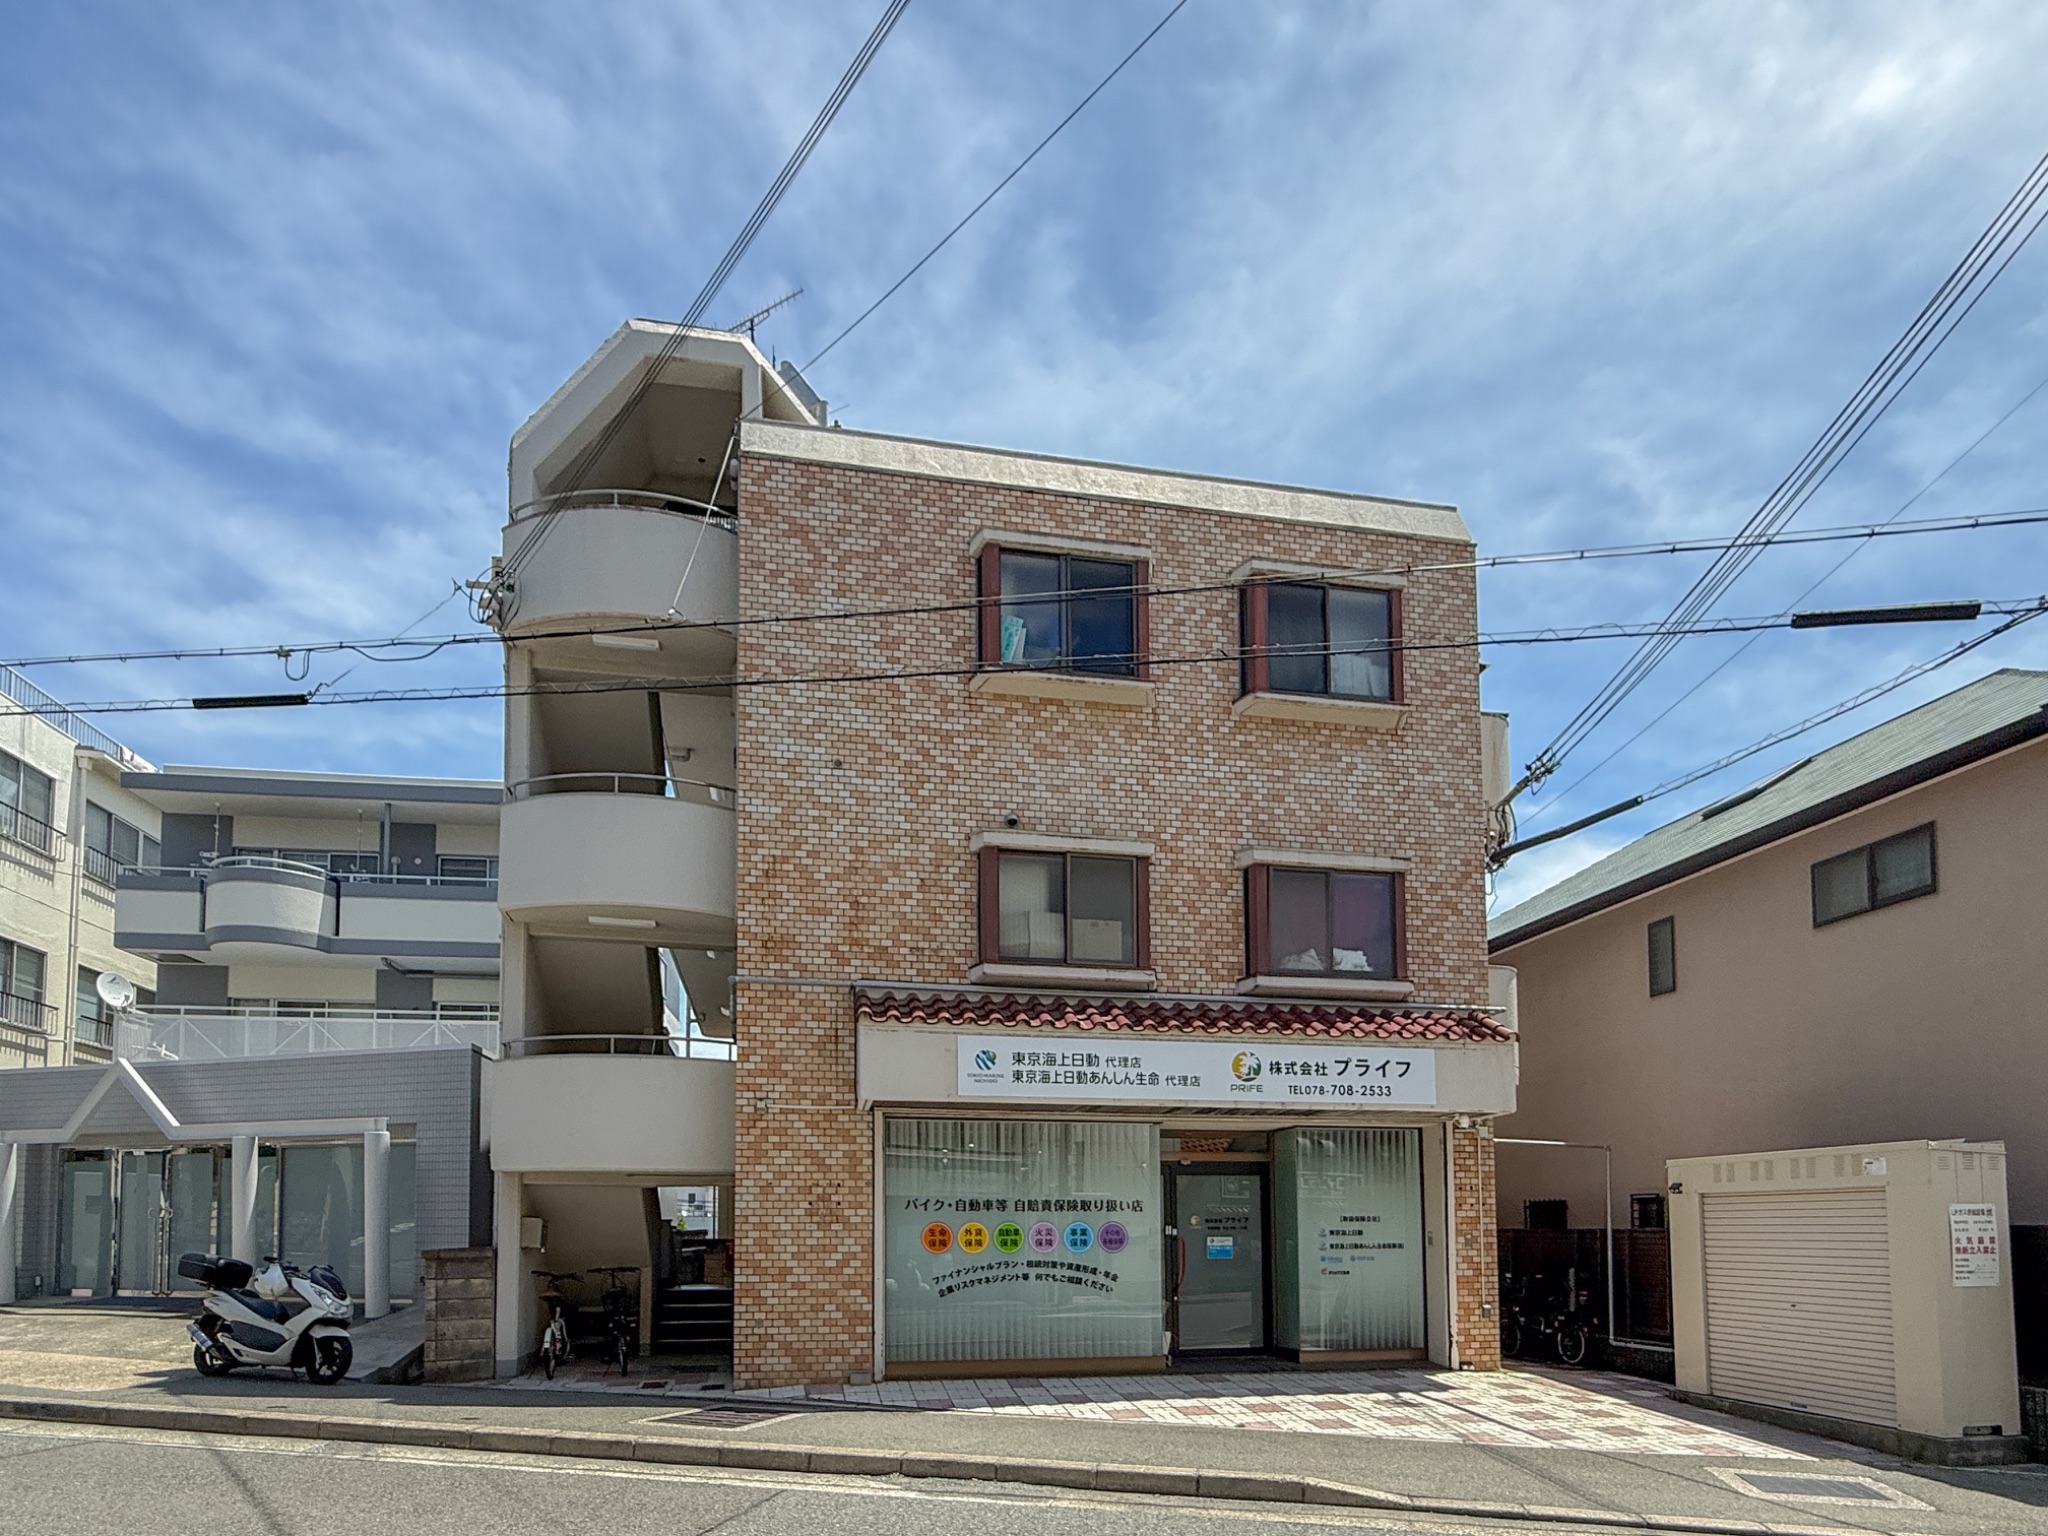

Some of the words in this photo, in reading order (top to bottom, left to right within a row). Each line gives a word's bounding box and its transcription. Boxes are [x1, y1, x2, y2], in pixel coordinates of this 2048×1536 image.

[1011, 1052, 1100, 1068] 東京海上日動
[1105, 1056, 1142, 1068] 代理店
[1269, 1060, 1328, 1076] 株式会社
[1334, 1057, 1411, 1078] プライフ
[1011, 1069, 1160, 1086] 東京海上日動あんしん生命
[1165, 1075, 1201, 1087] 代理店
[1288, 1085, 1392, 1097] TEL078-708-2533
[904, 1199, 1008, 1212] バイク・自動車等
[1014, 1199, 1144, 1213] 自賠責保険取り扱い店
[928, 1228, 947, 1237] 生命
[998, 1228, 1020, 1237] 自動車
[1035, 1228, 1053, 1237] 火災
[928, 1238, 948, 1247] 保険
[964, 1238, 983, 1247] 保険
[999, 1238, 1019, 1247] 保険
[1035, 1238, 1053, 1247] 保険
[1070, 1238, 1088, 1247] 保険
